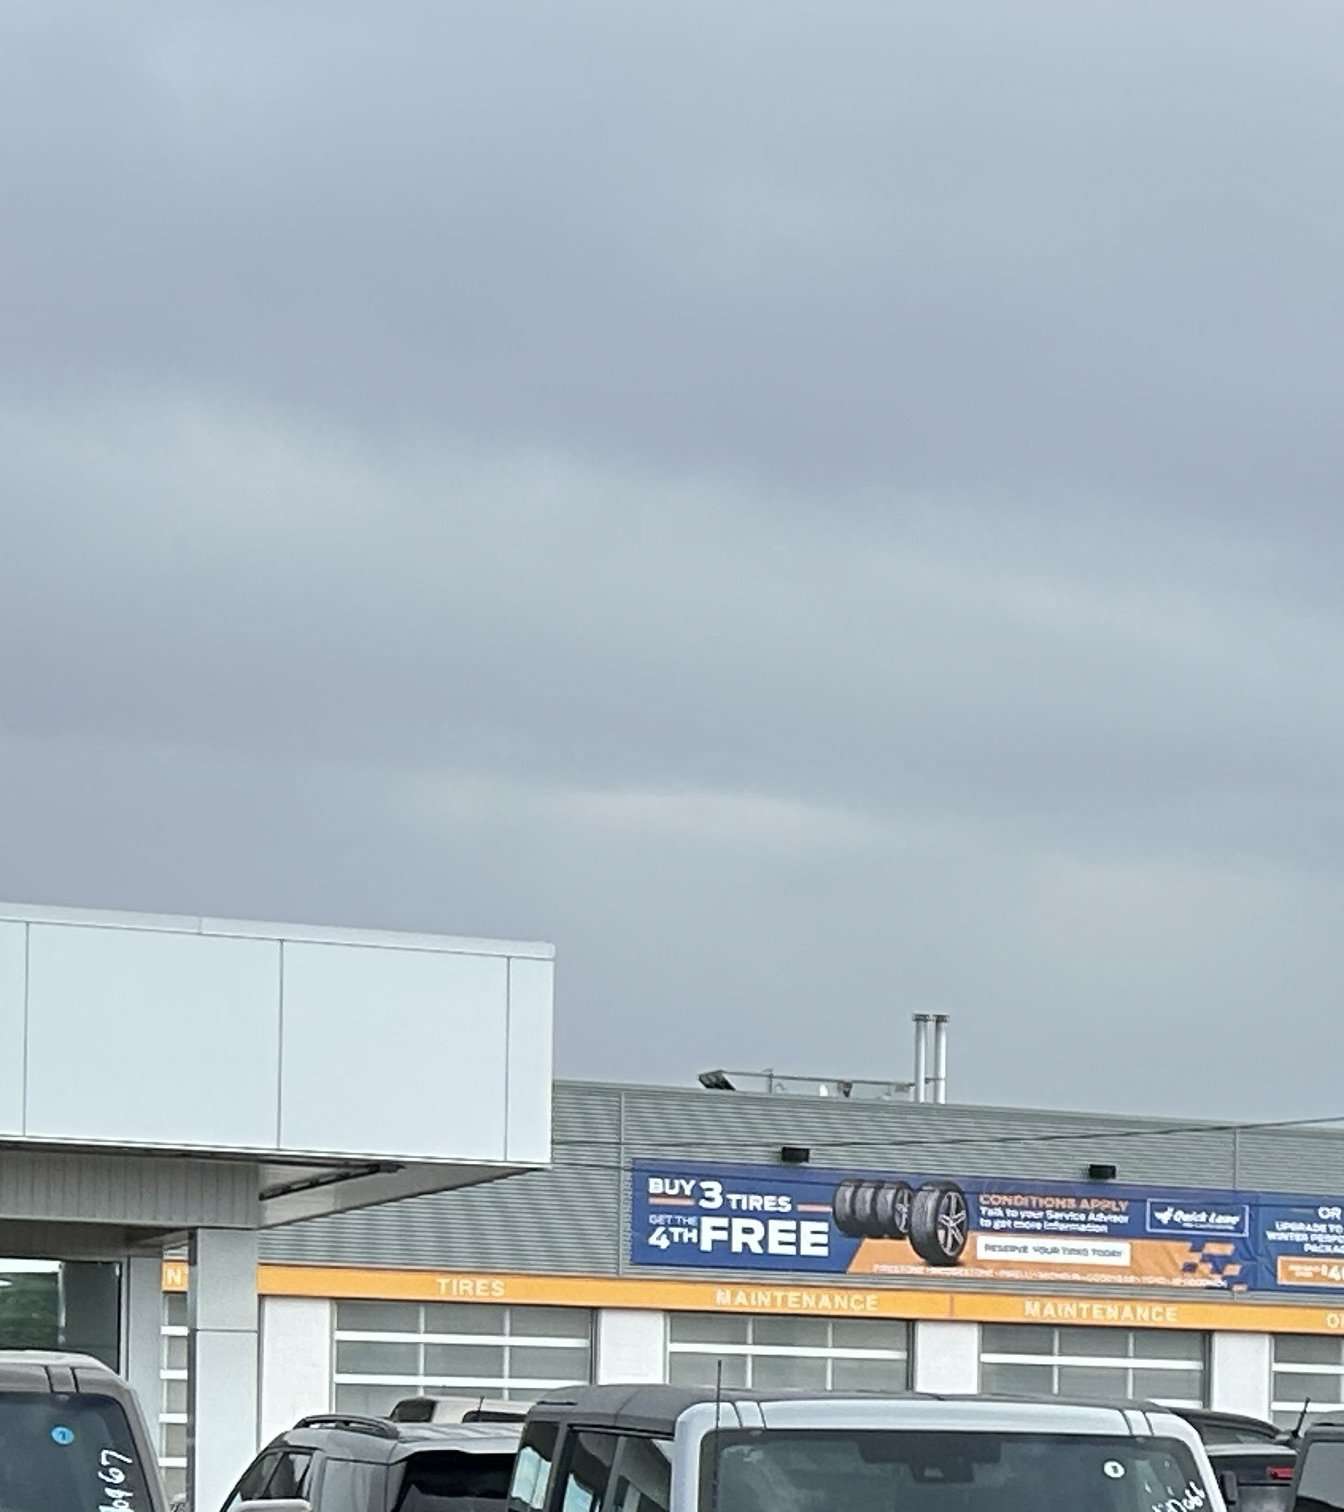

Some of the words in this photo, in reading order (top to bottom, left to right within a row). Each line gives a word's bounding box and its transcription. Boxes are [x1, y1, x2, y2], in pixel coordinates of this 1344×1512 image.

[648, 1177, 696, 1196] BUY
[698, 1180, 723, 1209] 3
[726, 1194, 792, 1213] TIRES
[978, 1194, 1076, 1209] CONDITIONS
[1079, 1199, 1129, 1212] APPLY
[649, 1214, 674, 1225] GET
[676, 1215, 698, 1226] THE
[980, 1206, 1004, 1217] Talk
[1006, 1208, 1018, 1218] to
[1020, 1210, 1044, 1219] your
[1046, 1209, 1086, 1221] Service
[1088, 1212, 1129, 1224] Advisor
[1317, 1206, 1342, 1220] OR
[980, 1218, 991, 1227] to
[993, 1219, 1011, 1230] get
[1013, 1221, 1042, 1230] more
[1275, 1221, 1327, 1232] UPGRADE
[1328, 1224, 1343, 1233] TO
[648, 1226, 698, 1249] 4TH
[700, 1216, 829, 1257] FREE
[1265, 1231, 1308, 1242] WINTER
[984, 1243, 1029, 1254] RESERVE
[1032, 1246, 1060, 1255] YOUR
[1062, 1246, 1089, 1257] TIRES
[1092, 1248, 1122, 1258] TODAY
[437, 1278, 505, 1297] TIRES
[715, 1288, 880, 1311] MAINTENANCE
[1024, 1300, 1179, 1322] MAINTENANCE
